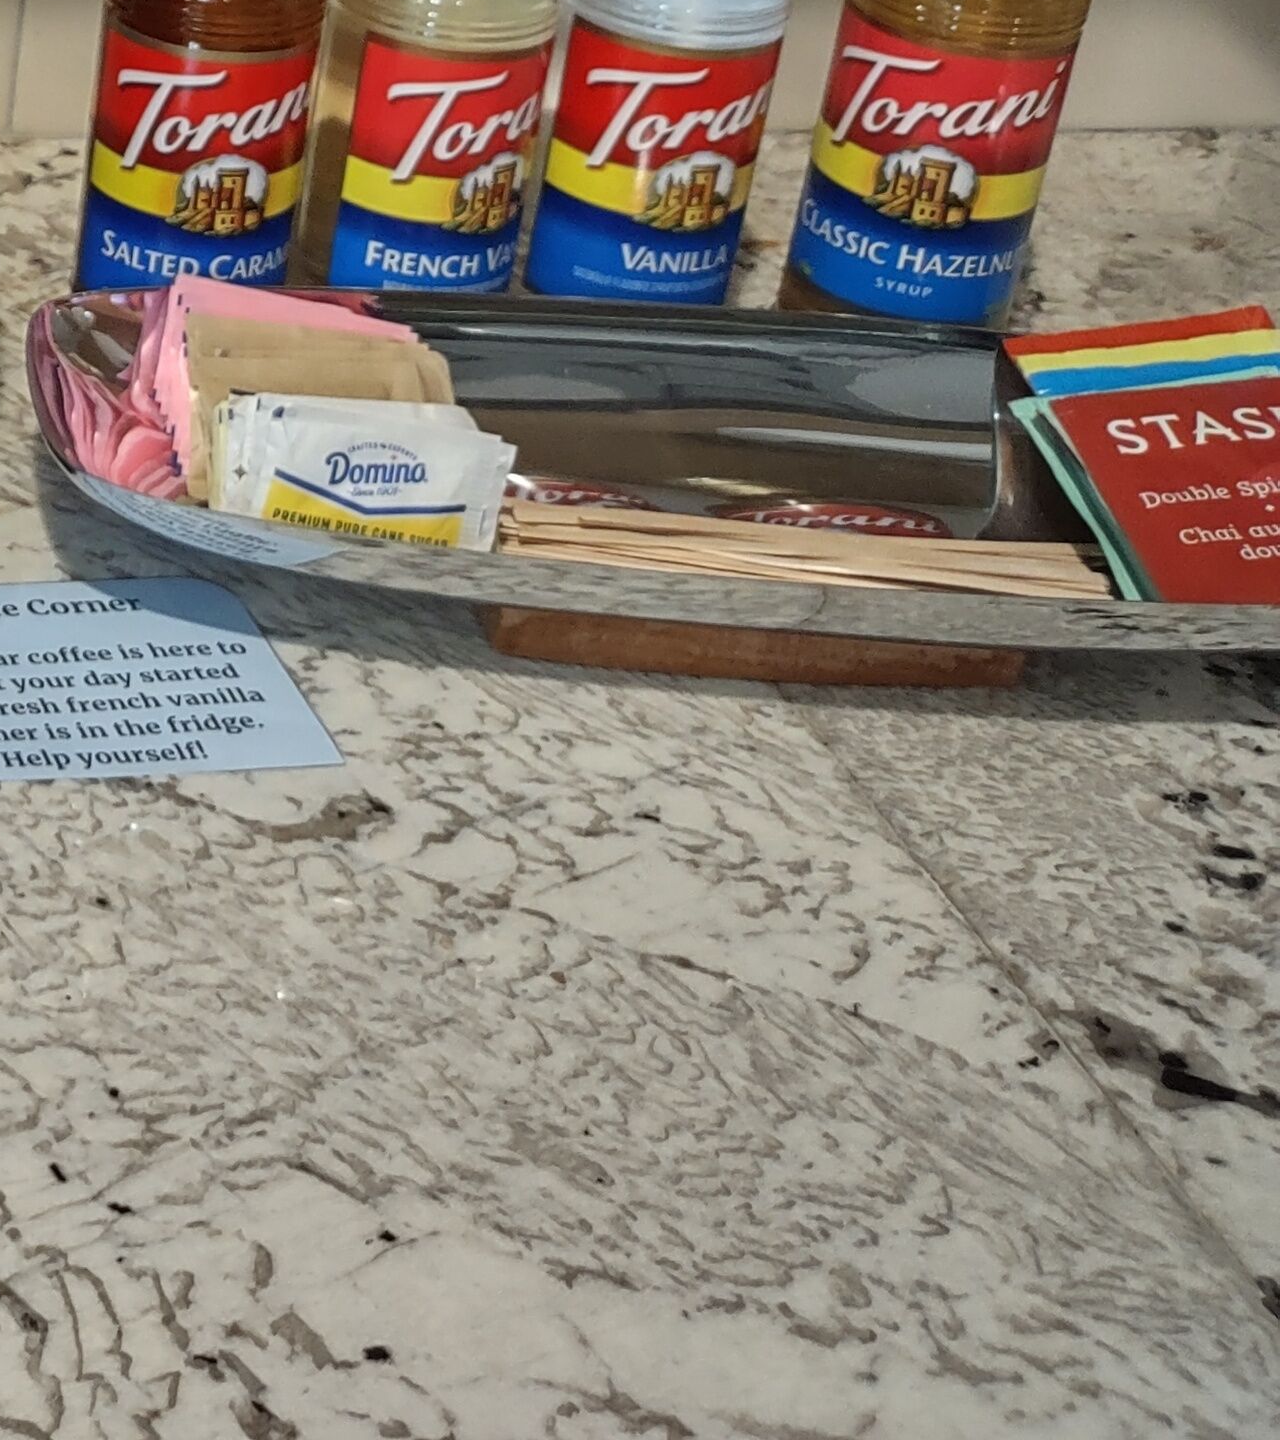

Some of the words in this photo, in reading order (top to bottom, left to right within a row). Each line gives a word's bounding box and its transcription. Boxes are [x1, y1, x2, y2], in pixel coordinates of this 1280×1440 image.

[831, 45, 1067, 143] Torani
[801, 198, 890, 266] CLASSIC
[100, 229, 200, 277] SALTED
[364, 239, 480, 279] FRENCH
[621, 242, 728, 274] VANILLA
[874, 275, 934, 298] SYRUP
[1106, 406, 1280, 455] STAS
[326, 451, 426, 485] Domino
[1138, 483, 1232, 509] Double
[1236, 476, 1280, 499] Spi
[272, 507, 331, 531] PREMIUM
[335, 521, 368, 536] PURE
[1178, 523, 1244, 545] Chai
[26, 595, 142, 616] Corner
[27, 645, 114, 665] coffee
[117, 643, 144, 660] is
[146, 642, 213, 659] here
[217, 640, 247, 655] to
[10, 674, 76, 695] your
[83, 669, 132, 689] day
[139, 662, 241, 684] started
[66, 692, 162, 714] french
[165, 686, 266, 707] vanilla
[44, 722, 72, 740] is
[76, 721, 109, 739] in
[113, 718, 163, 737] the
[167, 713, 265, 735] fridge.
[0, 748, 72, 771] Help
[76, 739, 209, 770] yourself!
